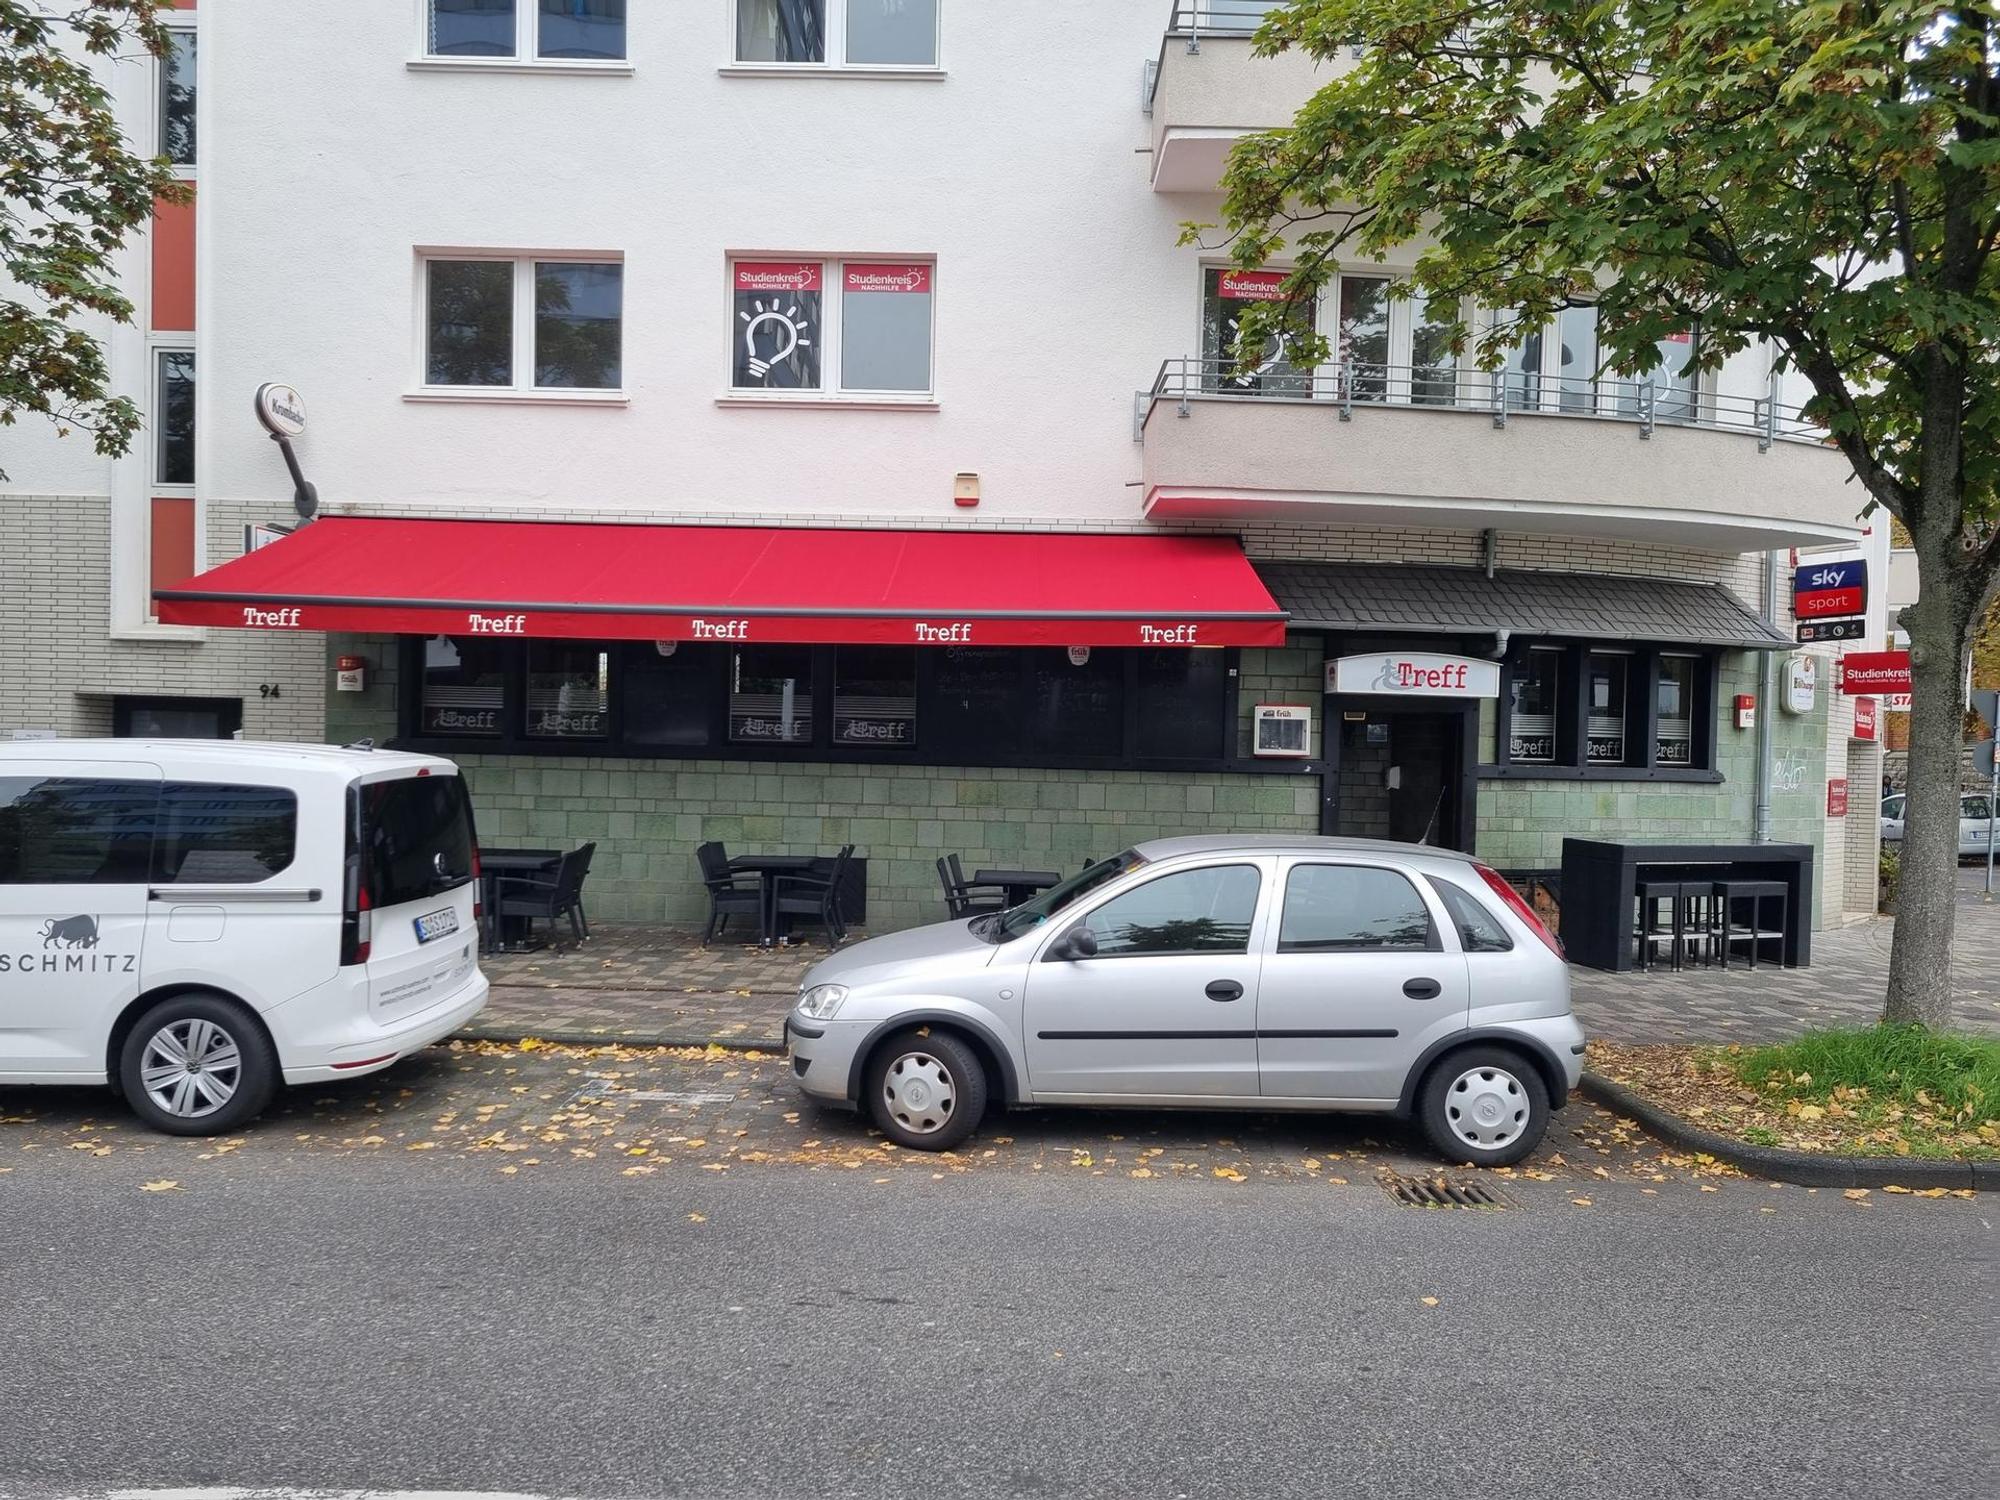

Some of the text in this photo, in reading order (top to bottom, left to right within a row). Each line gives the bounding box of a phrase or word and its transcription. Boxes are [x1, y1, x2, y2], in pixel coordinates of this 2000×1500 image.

[740, 272, 803, 283] Studienkreis
[849, 273, 912, 285] Studienkreis
[1223, 279, 1280, 292] Studienkrei
[1811, 569, 1846, 587] sky
[1808, 595, 1848, 611] sport
[244, 608, 301, 626] Treff
[469, 614, 526, 633] Treff
[692, 620, 749, 639] Treff
[915, 623, 972, 642] Treff
[1141, 625, 1197, 643] Treff
[1398, 663, 1468, 688] Treff
[260, 684, 280, 698] 94
[0, 954, 135, 972] SCHMITZ
